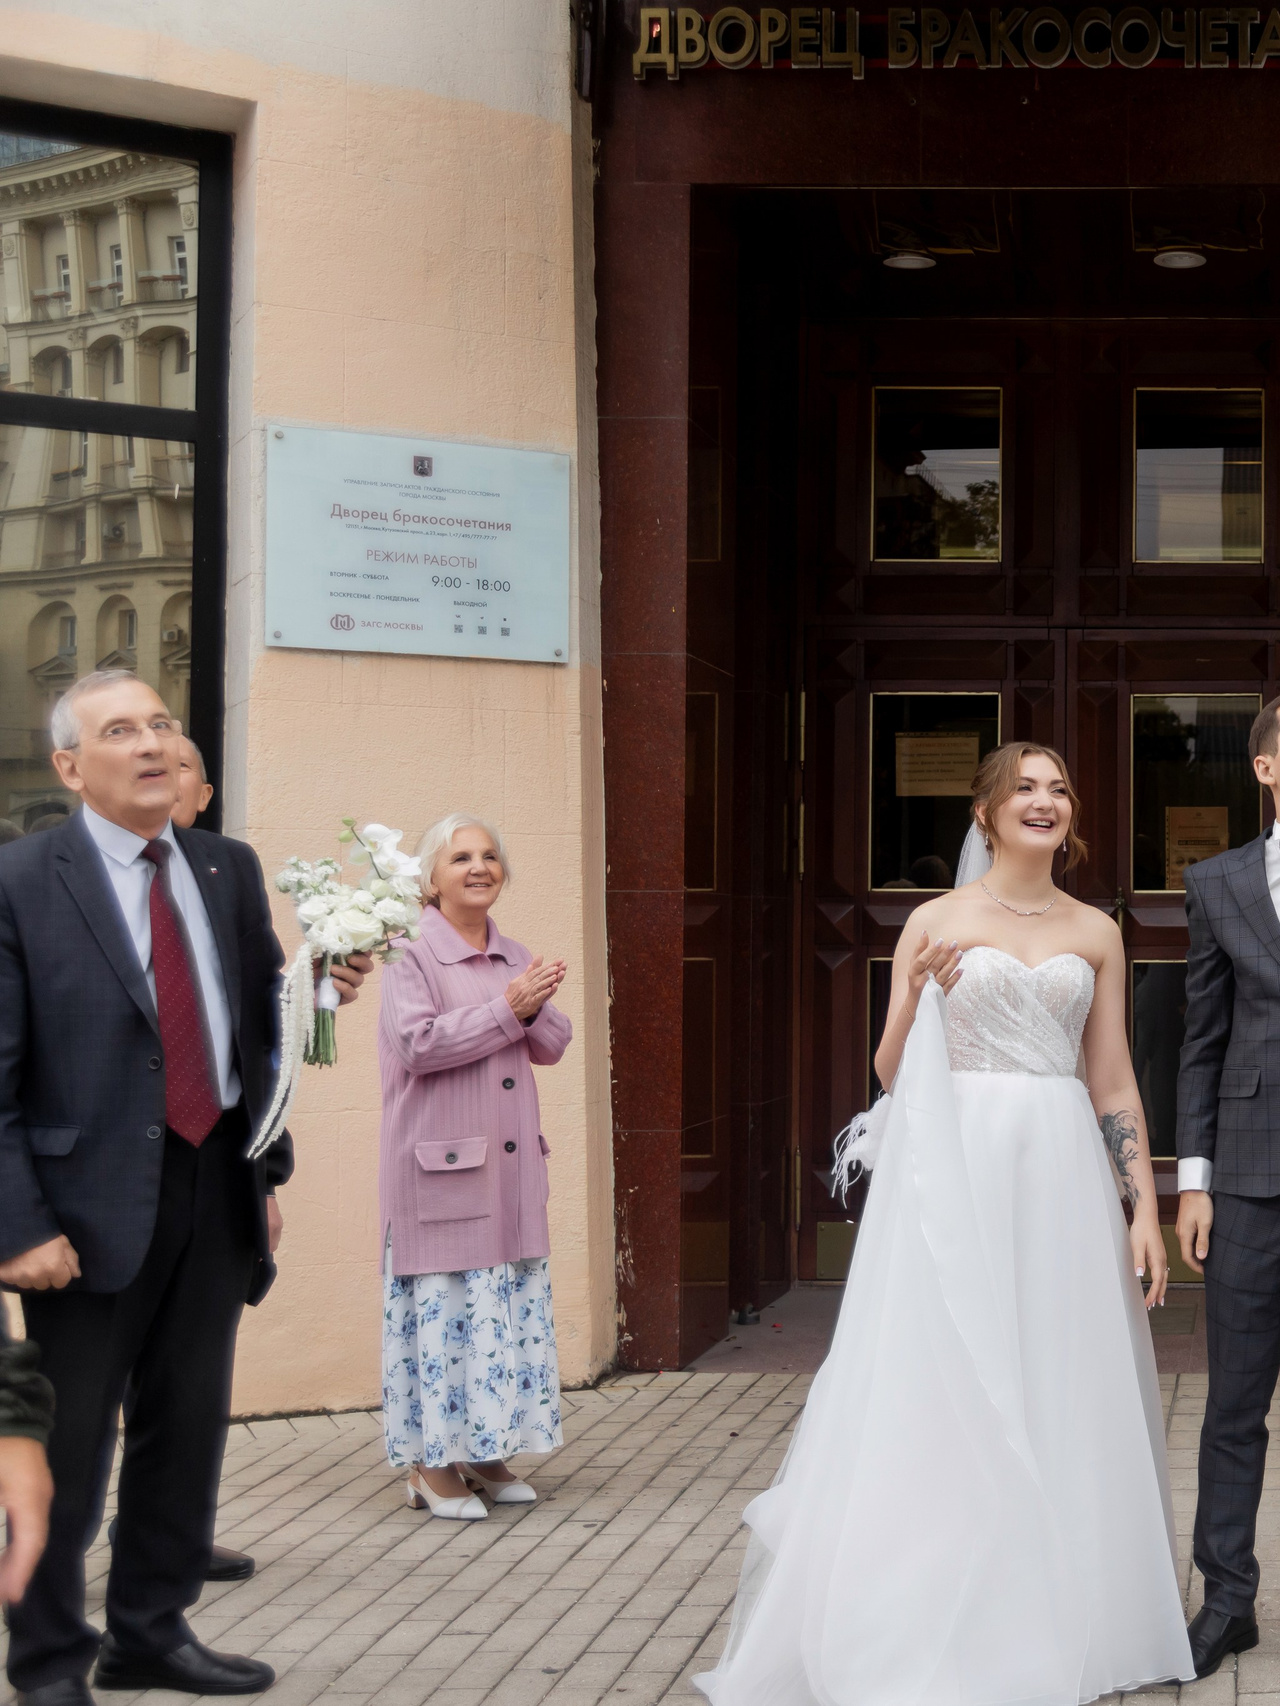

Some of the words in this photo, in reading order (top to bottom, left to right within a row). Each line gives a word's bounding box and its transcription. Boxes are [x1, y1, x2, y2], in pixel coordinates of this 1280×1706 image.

[632, 6, 864, 80] ДВОРЕЦ
[343, 478, 379, 487] УПРАВЛЕНИЕ
[380, 481, 404, 489] ЗАПИСИ
[404, 483, 422, 491] АКТОВ
[423, 485, 466, 495] ГРАЖДАНСКОГО
[467, 489, 501, 498] СОСТОЯНИЯ
[421, 493, 447, 501] МОСКВЫ
[330, 503, 389, 522] Дворец
[392, 509, 512, 532] бракосочетания
[366, 549, 419, 564] РЕЖИМ
[424, 553, 477, 569] РАБОТЫ
[329, 571, 358, 579] ВТОРНИК
[362, 573, 390, 581] СУББОТА
[431, 575, 462, 589] 9:00
[476, 578, 511, 592] 18:00
[329, 591, 371, 600] ВОСКРЕСЕНЬЕ
[375, 594, 421, 603] ПОНЕДЕЛЬНИК
[453, 600, 488, 608] ВЫХОДНОЙ
[360, 620, 383, 629] ЗАГС
[383, 622, 424, 631] МОСКВЫ
